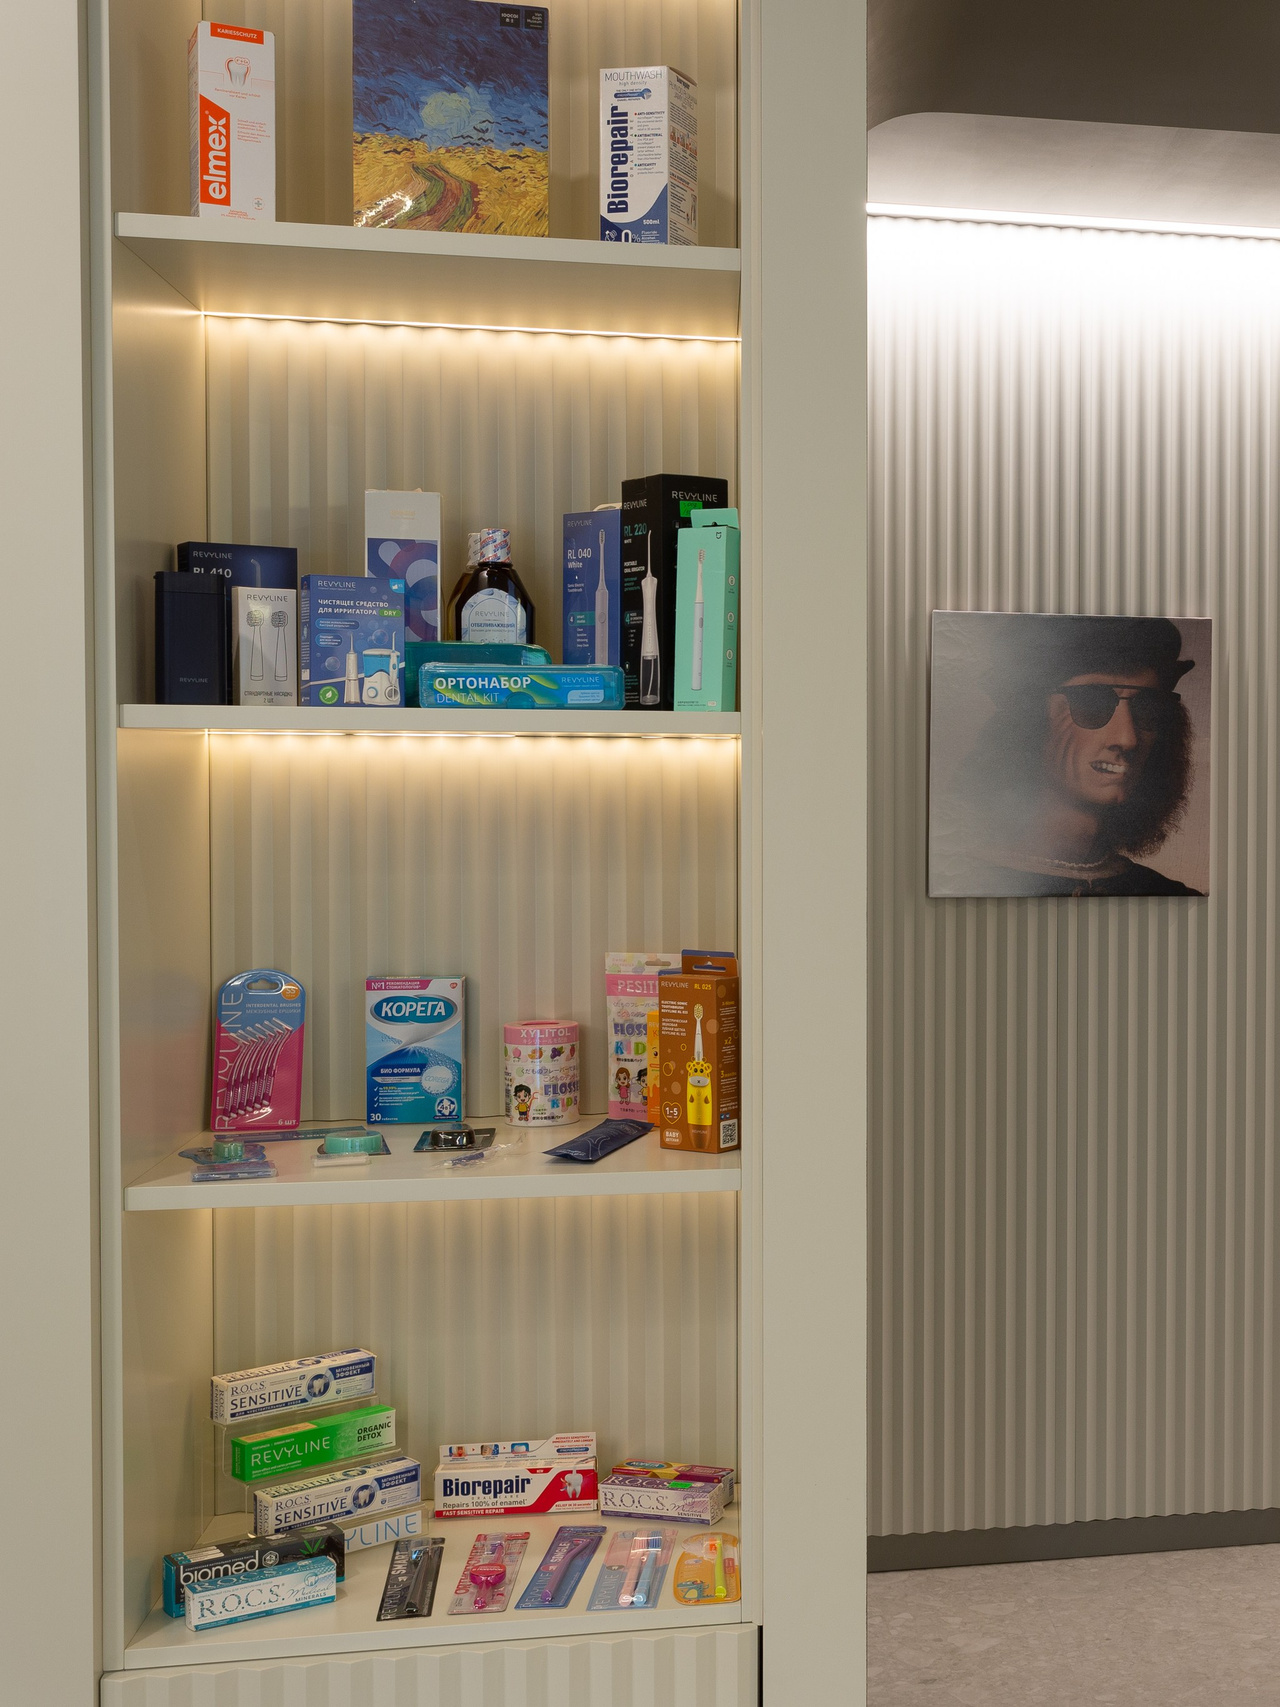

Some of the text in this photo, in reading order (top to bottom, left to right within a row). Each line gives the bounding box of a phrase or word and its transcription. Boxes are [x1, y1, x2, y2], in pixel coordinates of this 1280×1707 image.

[217, 28, 257, 39] KARIESSCHUTZ
[604, 69, 663, 82] MOUTHWASH
[203, 114, 227, 200] elmex
[607, 105, 634, 214] Biorepair
[672, 490, 718, 503] REVYLINE
[623, 498, 648, 510] REVYLINE
[567, 519, 593, 528] REVYLINE
[624, 523, 648, 537] RL 220
[192, 550, 233, 560] REVYLINE
[567, 547, 592, 560] RL 040
[567, 561, 583, 569] White
[317, 580, 356, 589] REVYLINE
[246, 593, 288, 603] REVYLINE
[317, 599, 389, 608] ЧИСТЯЩЕЕ СРЕДСТВО
[625, 613, 630, 625] 4
[434, 676, 532, 690] ОРТОНАБОР
[561, 676, 601, 684] REVYLINE
[436, 693, 500, 704] DENTAL KIT
[371, 981, 385, 990] №1
[660, 980, 689, 989] REVYLINE
[701, 983, 712, 991] 025
[381, 1001, 446, 1017] КОРЕГА
[520, 1028, 571, 1038] XYLITOL
[615, 1040, 647, 1056] KID
[720, 1070, 725, 1078] 3
[551, 1096, 578, 1109] KIDS
[370, 1113, 382, 1121] 30
[665, 1106, 678, 1116] 1-5
[335, 1361, 370, 1373] МГНОВЕННЫЙ
[335, 1368, 361, 1379] ЭФФЕКТ
[230, 1380, 267, 1397] R.O.C.S.
[230, 1385, 303, 1411] SENSITIVE
[357, 1421, 392, 1435] ORGANIC
[357, 1430, 382, 1443] DETOX
[251, 1436, 331, 1467] REVYLINE
[381, 1470, 416, 1483] МГНОВЕННЫЙ
[381, 1477, 407, 1488] ЭФФЕКТ
[442, 1475, 531, 1499] Biorepair
[275, 1494, 312, 1511] R.O.C.S.
[442, 1501, 470, 1509] Repairs
[602, 1491, 669, 1511] R.O.C.S.
[275, 1497, 347, 1527] SENSITIVE
[550, 1542, 571, 1563] SINGLE
[180, 1549, 259, 1585] biomed
[390, 1551, 409, 1575] SMART
[198, 1584, 286, 1619] R.O.C.S.
[295, 1591, 327, 1603] MINERALS
[380, 1583, 403, 1620] REVYLINE
